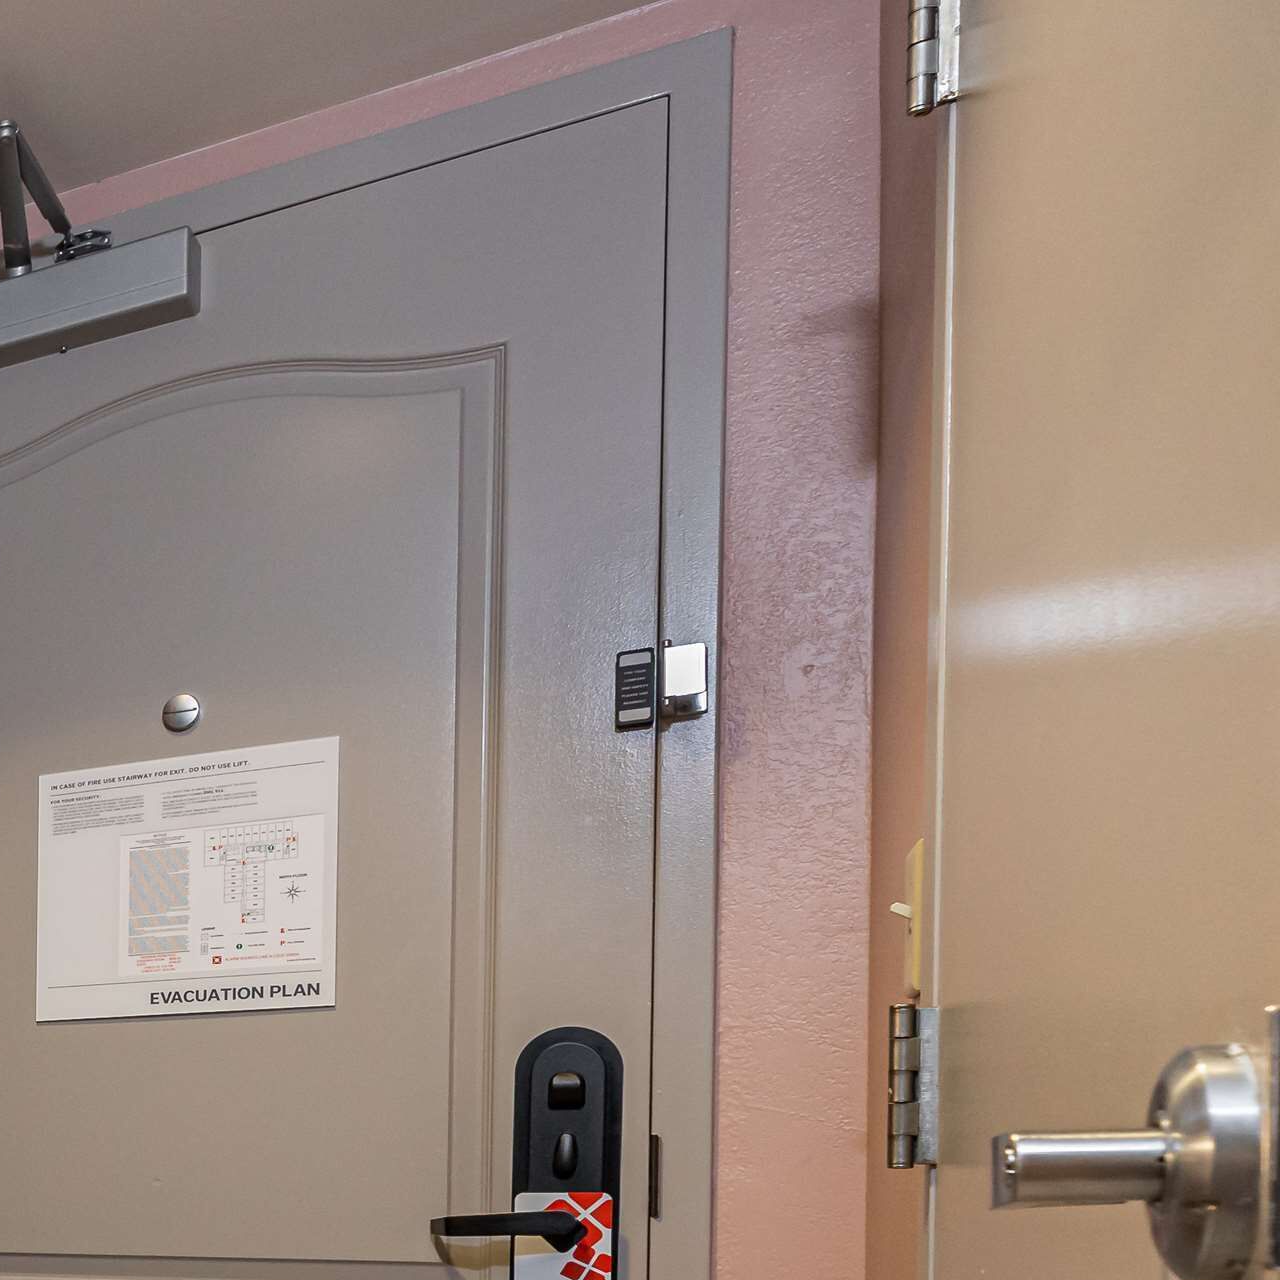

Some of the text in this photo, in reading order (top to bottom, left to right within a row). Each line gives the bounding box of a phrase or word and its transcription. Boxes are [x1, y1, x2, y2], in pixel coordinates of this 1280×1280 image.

[117, 773, 153, 782] STAIRWAY
[149, 982, 321, 1005] EVACUATION PLAN
